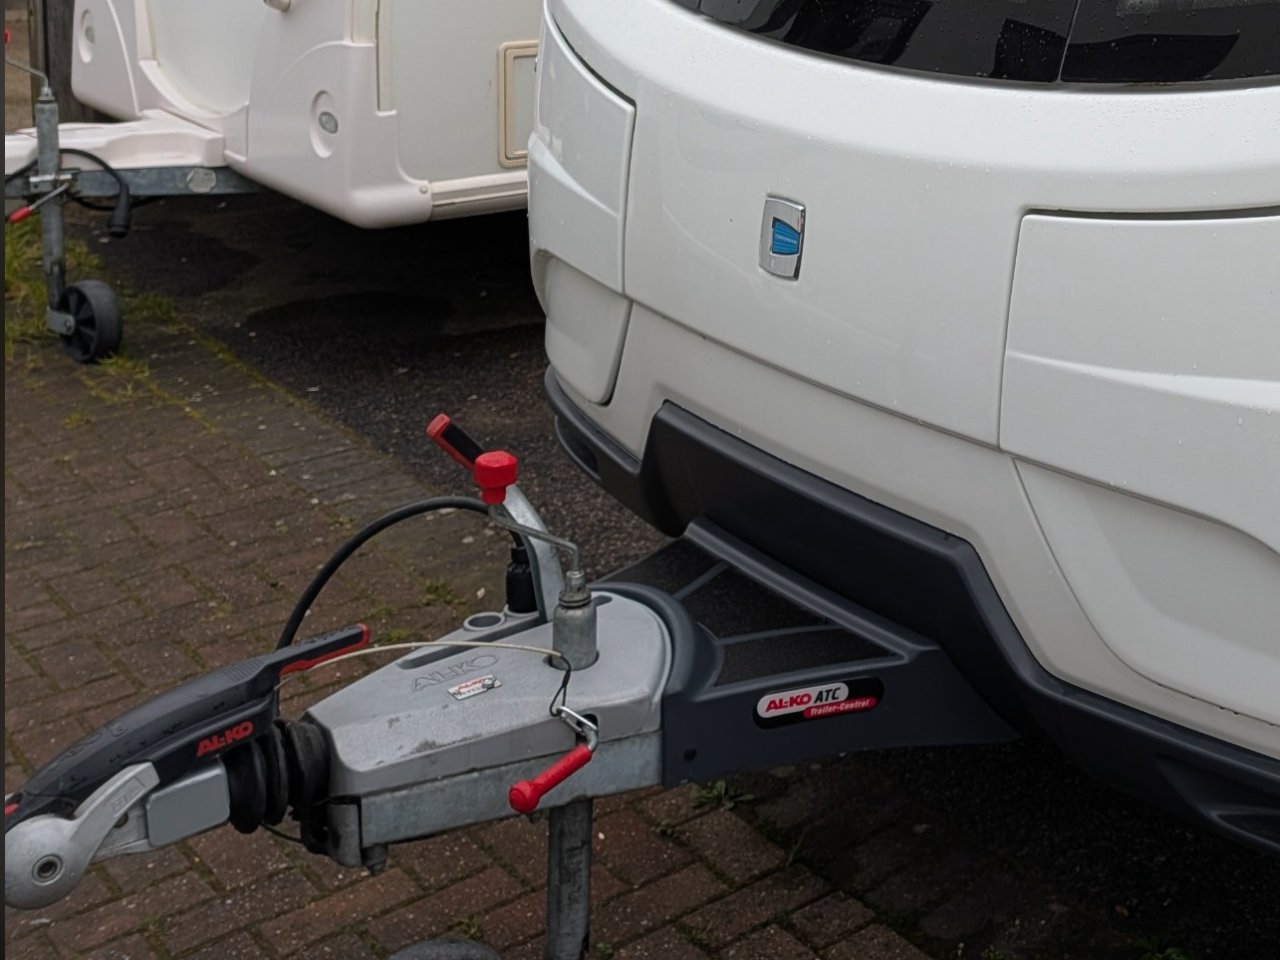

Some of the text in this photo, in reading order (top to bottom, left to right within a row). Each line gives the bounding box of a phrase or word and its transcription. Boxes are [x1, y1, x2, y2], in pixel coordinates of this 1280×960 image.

[764, 686, 842, 714] AL-KO ATC
[809, 698, 871, 717] Trailer-Control
[196, 720, 254, 758] AL-KO
